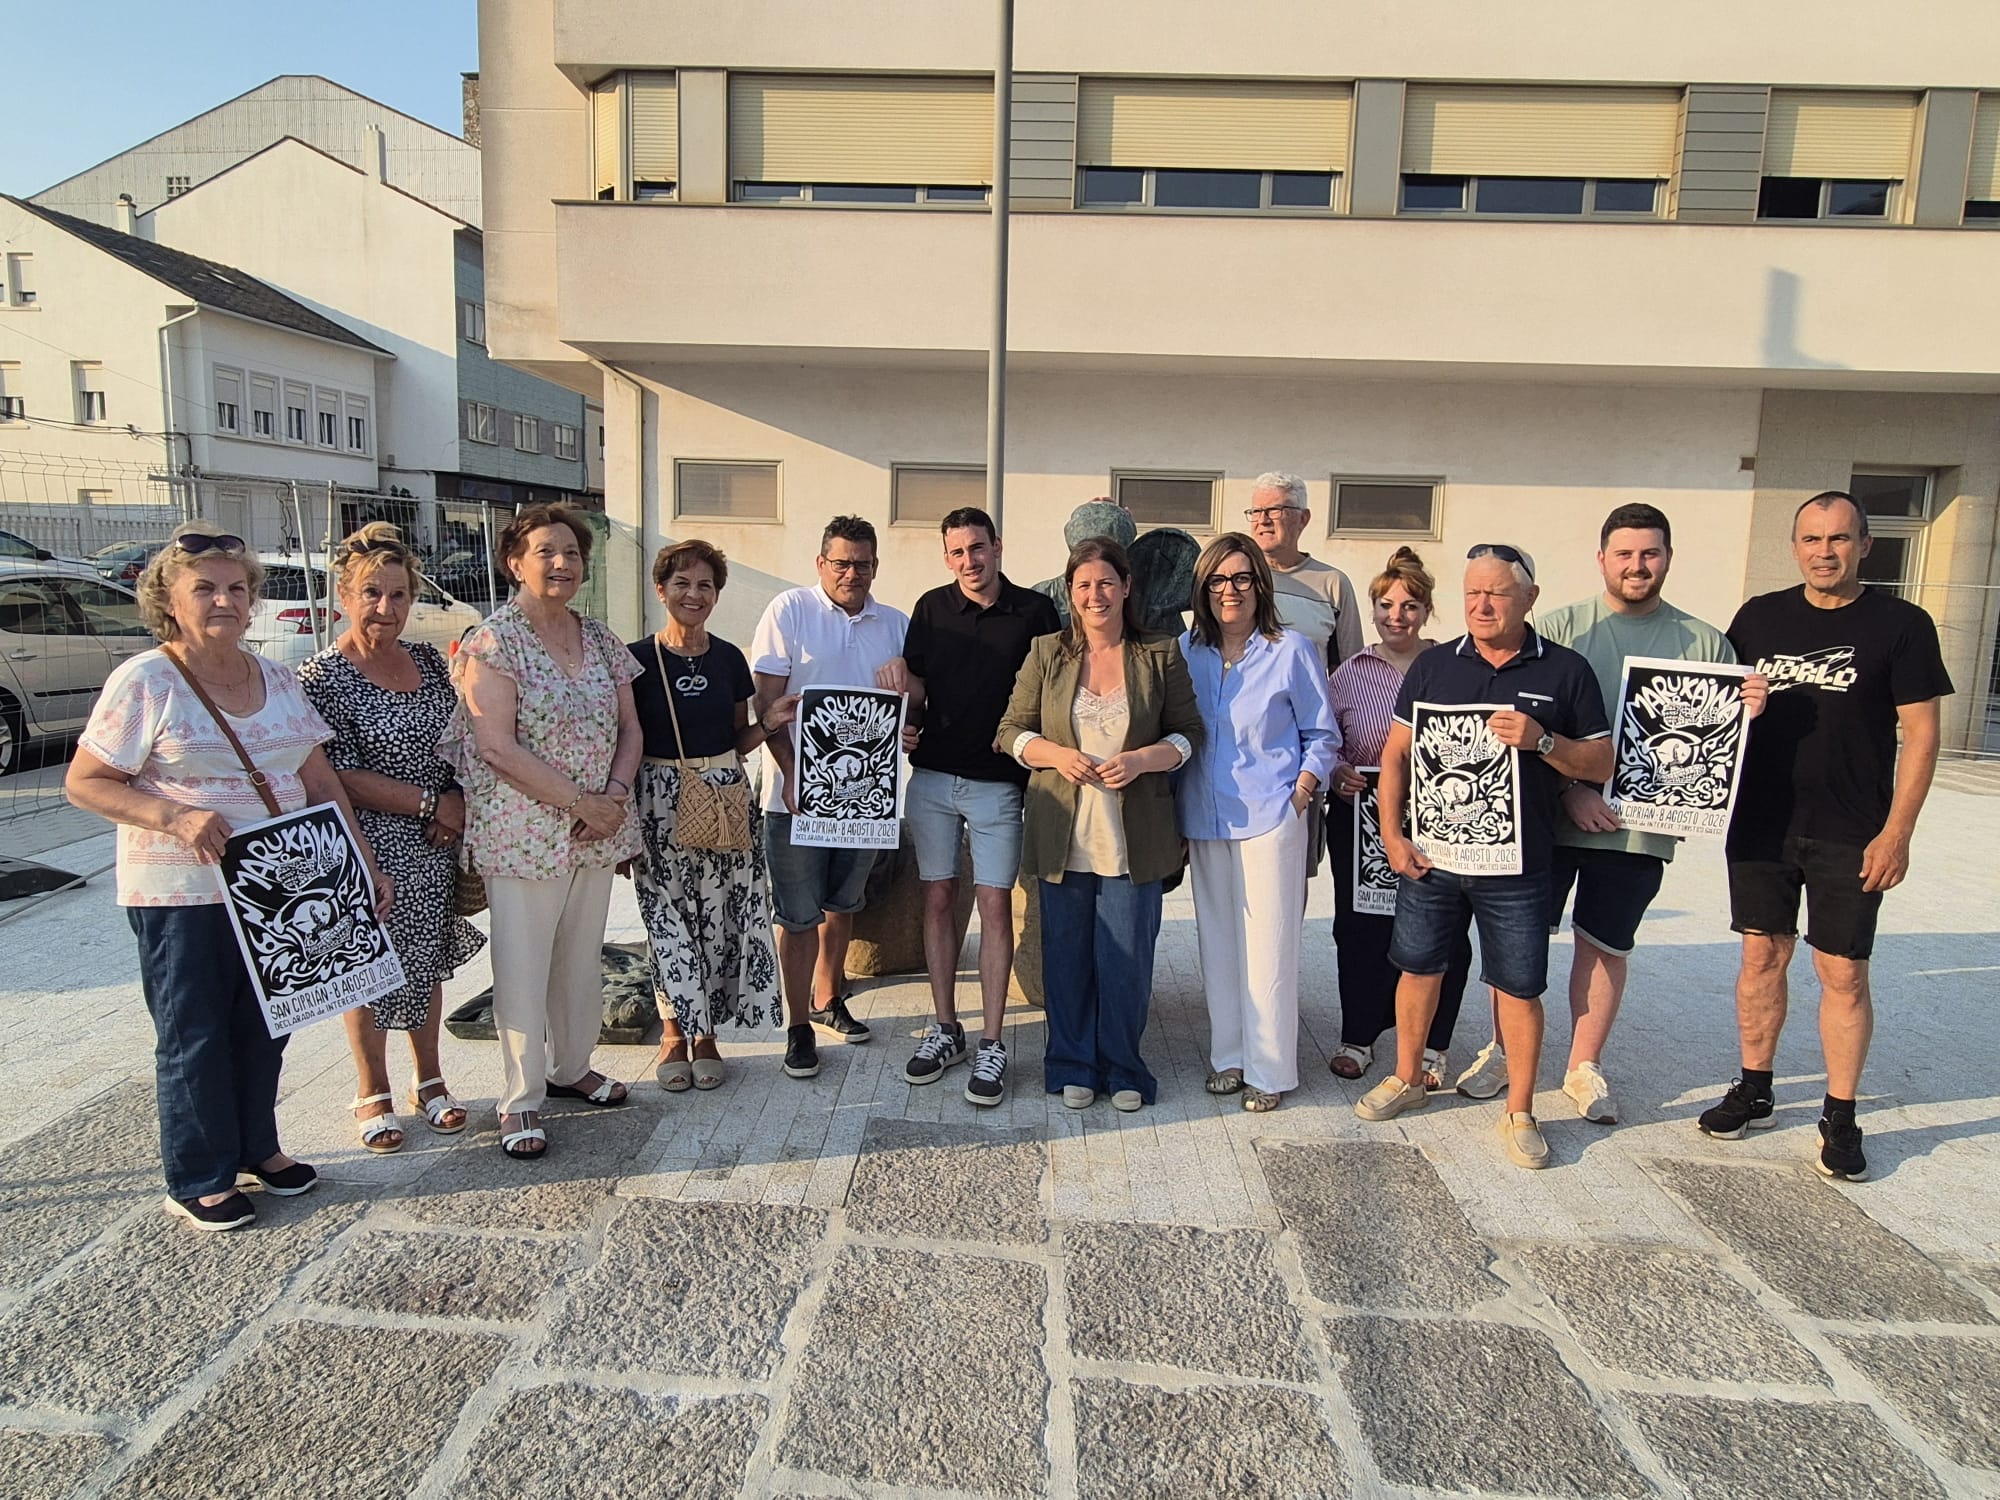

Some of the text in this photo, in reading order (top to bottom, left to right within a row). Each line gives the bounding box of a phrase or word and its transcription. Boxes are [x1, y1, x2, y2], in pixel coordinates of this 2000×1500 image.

[1659, 809, 1666, 822] 8
[1666, 809, 1700, 826] AGOSTO
[1701, 812, 1726, 828] 2026
[796, 819, 810, 833] SAN
[841, 822, 846, 836] 8
[846, 822, 875, 837] AGOSTO
[877, 823, 896, 837] 2026
[1454, 847, 1460, 861] 8
[1460, 847, 1491, 863] AGOSTO
[1494, 848, 1517, 863] 2026
[1357, 889, 1371, 903] SAN
[270, 1002, 290, 1020] SAN
[291, 986, 329, 1013] CIPRIÁN
[333, 981, 341, 998] 8
[341, 968, 376, 996] AGOSTO
[376, 957, 397, 980] 2026
[274, 1010, 316, 1031] DECLARADA
[325, 994, 359, 1012] INTERESE
